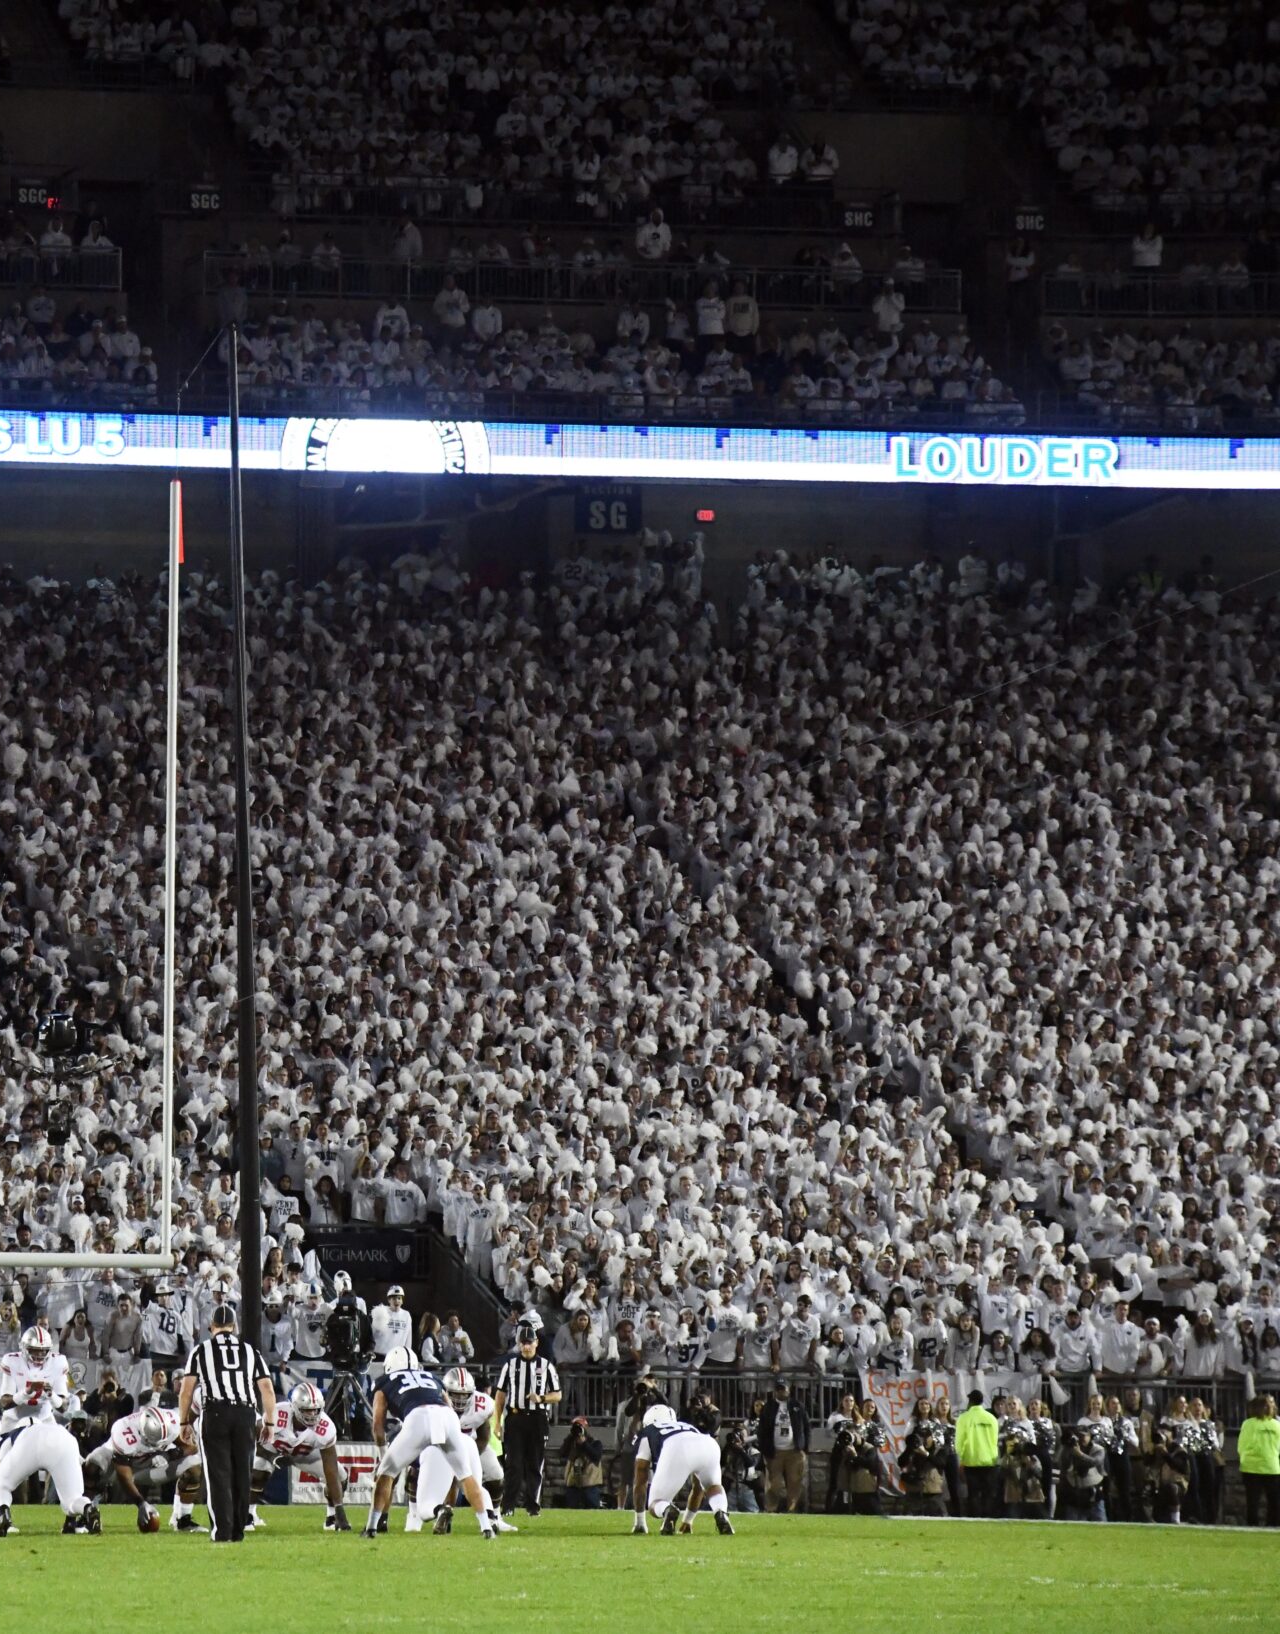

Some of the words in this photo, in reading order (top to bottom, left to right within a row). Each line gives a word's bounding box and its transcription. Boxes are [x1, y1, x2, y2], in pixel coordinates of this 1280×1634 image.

[19, 187, 48, 204] SGC
[24, 415, 82, 455] LU
[95, 418, 126, 457] 5
[890, 437, 1119, 481] LOUDER
[589, 500, 628, 530] SG
[159, 1312, 176, 1334] 18
[1024, 1311, 1035, 1330] 5
[218, 1345, 240, 1370] U
[390, 1369, 438, 1395] 36
[866, 1370, 949, 1403] Green
[475, 1395, 486, 1413] 75
[122, 1426, 138, 1446] 73
